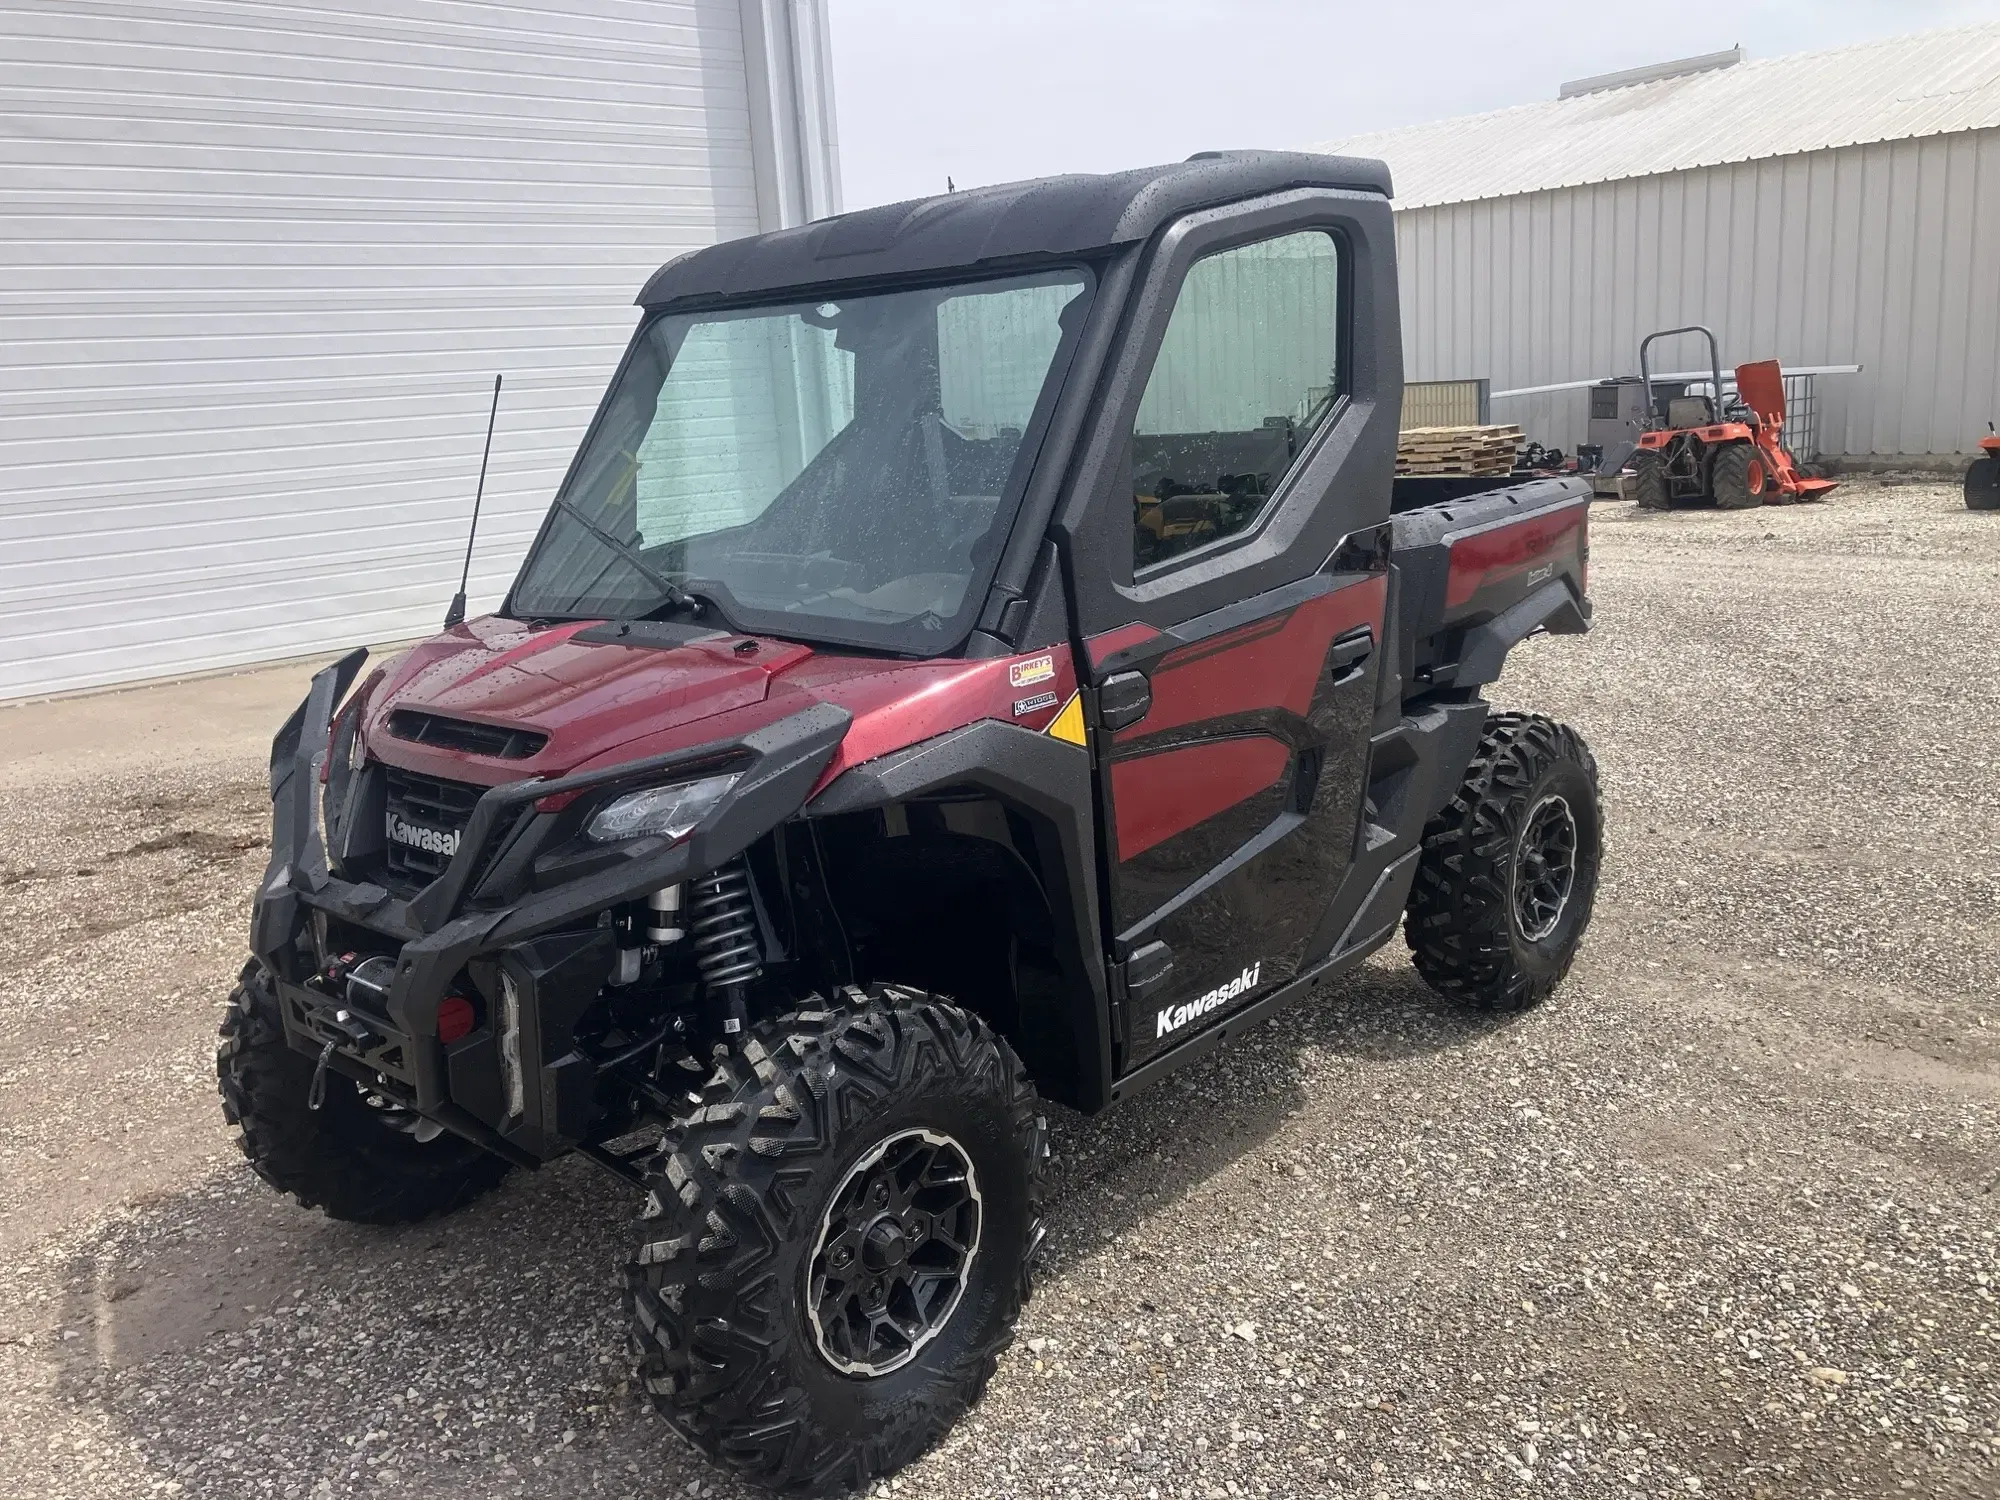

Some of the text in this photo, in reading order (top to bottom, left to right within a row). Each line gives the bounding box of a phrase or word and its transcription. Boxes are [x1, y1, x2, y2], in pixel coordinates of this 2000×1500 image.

[1011, 657, 1052, 682] BIRKEY'S
[385, 811, 461, 856] Kawasa
[1156, 960, 1261, 1039] Kawasaki
